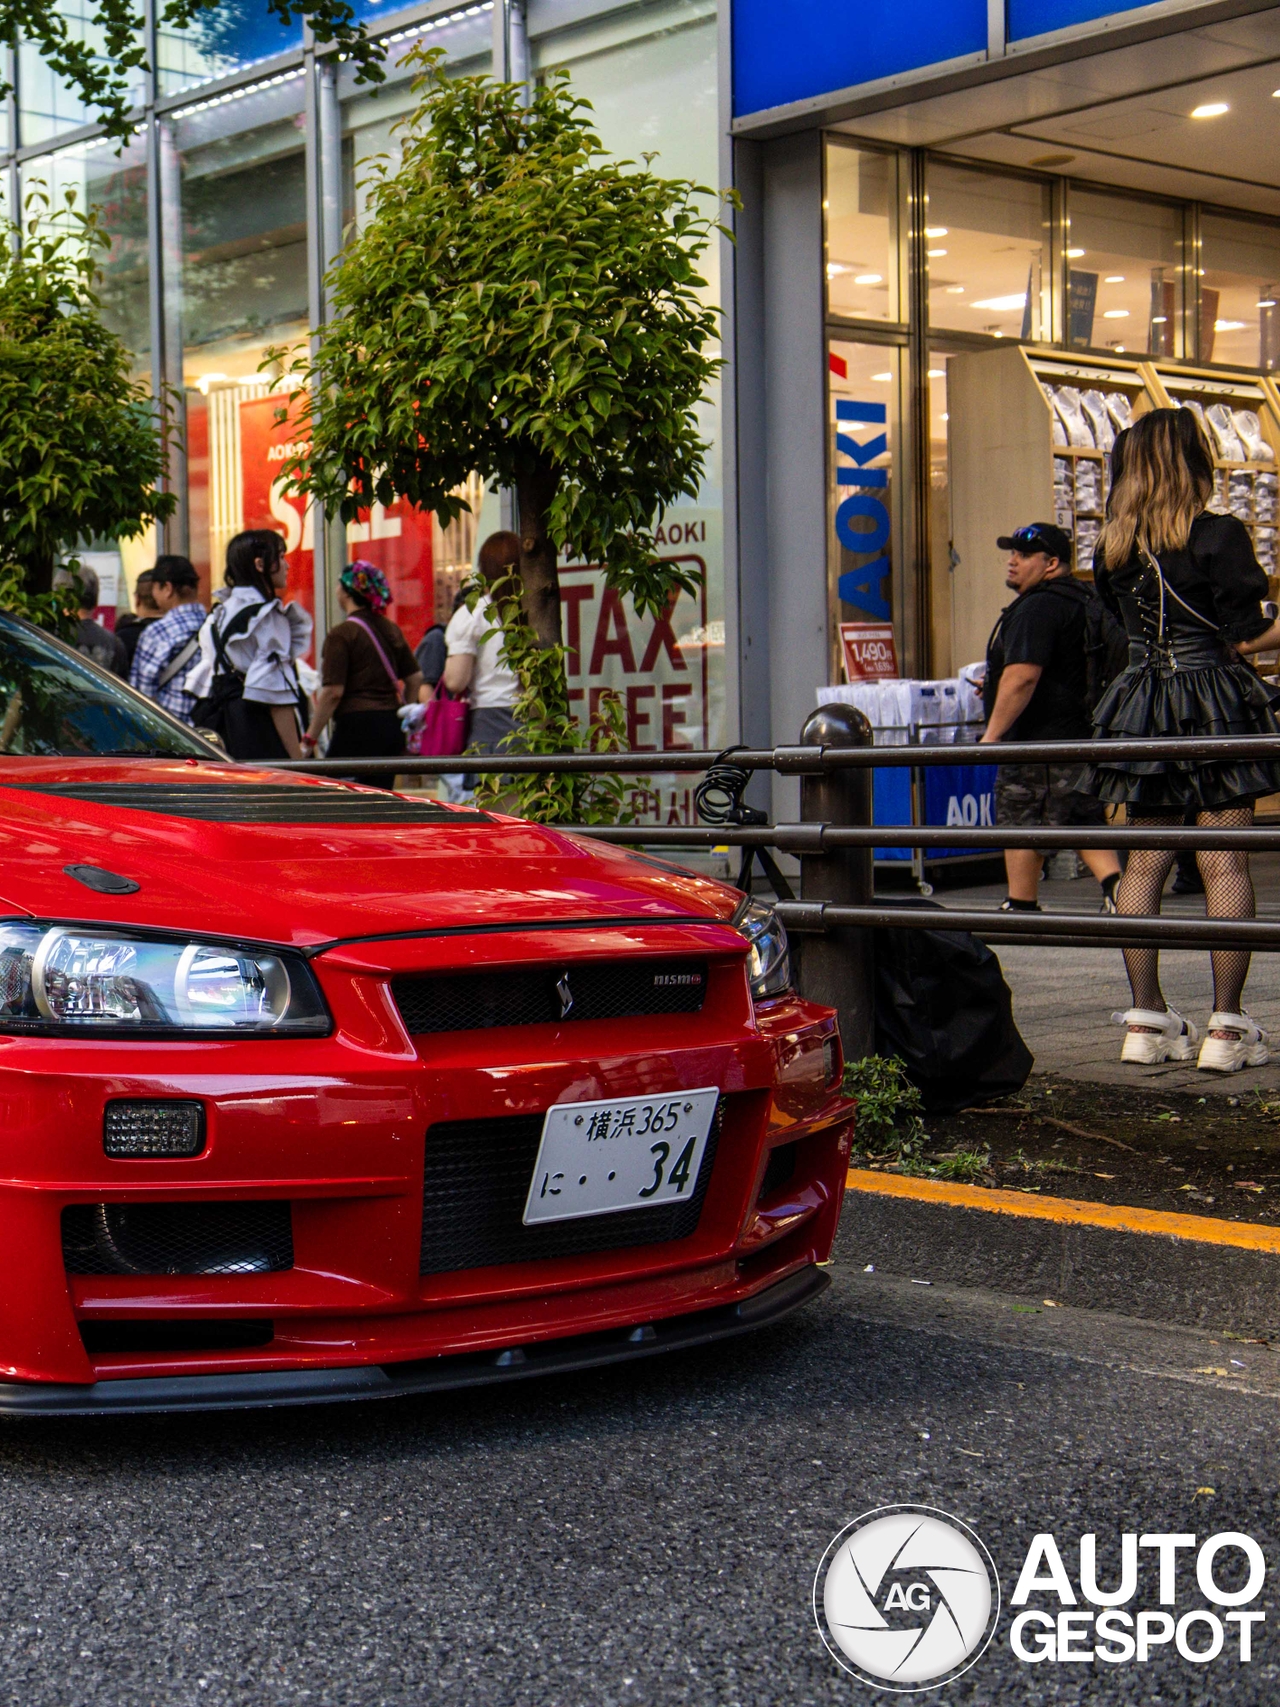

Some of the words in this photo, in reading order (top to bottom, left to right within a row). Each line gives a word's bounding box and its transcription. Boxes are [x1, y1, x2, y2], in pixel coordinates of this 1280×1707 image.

[654, 520, 706, 546] AOKI
[836, 399, 890, 622] AOKI
[559, 577, 687, 676] TAX
[946, 792, 993, 827] AOK
[540, 1172, 565, 1198] に
[638, 1136, 697, 1198] 34
